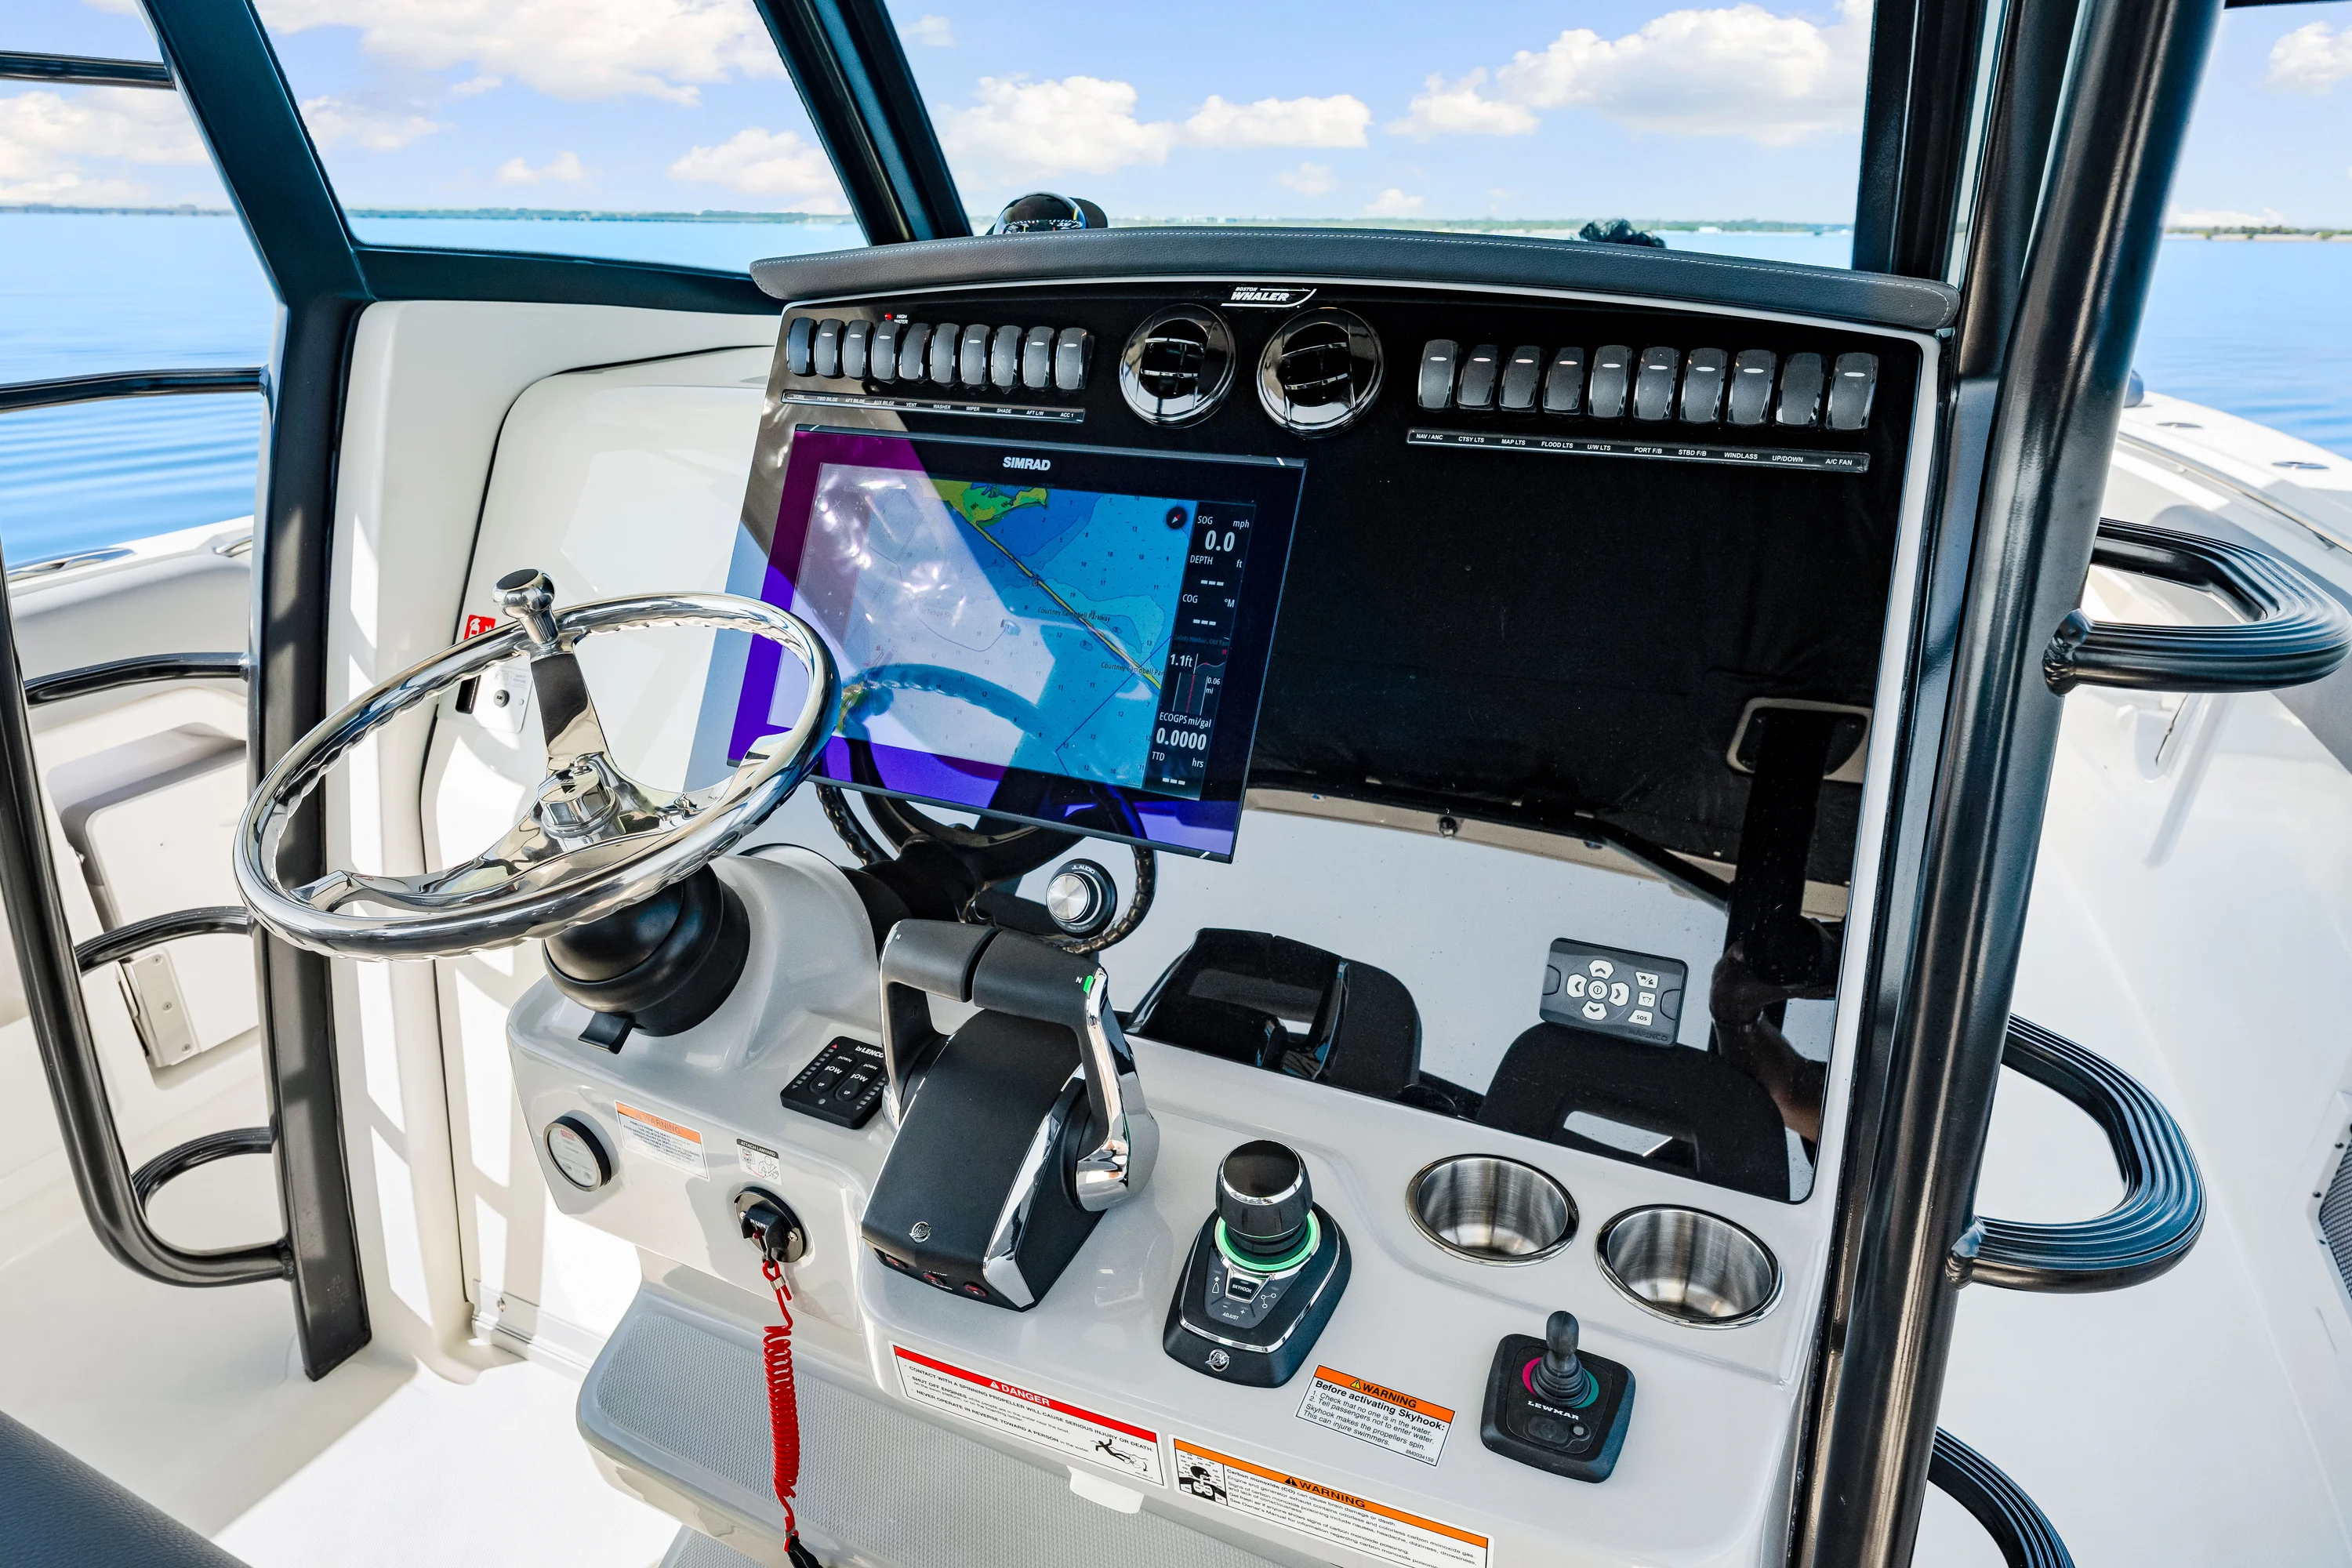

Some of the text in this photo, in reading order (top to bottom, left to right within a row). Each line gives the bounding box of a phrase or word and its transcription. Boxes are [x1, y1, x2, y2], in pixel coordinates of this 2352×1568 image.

[1230, 292, 1290, 301] WHALER
[1003, 456, 1051, 470] SIMRAD
[1197, 516, 1250, 530] SOG mph
[1205, 530, 1236, 552] 0.0
[1190, 555, 1243, 568] DEPTH ft
[1182, 594, 1235, 608] COG °M
[1038, 607, 1111, 622] Courtney Campbell Parkway
[1101, 661, 1125, 672] Courtney
[1127, 664, 1153, 675] Campbell
[1171, 654, 1192, 667] 1.1ft
[1160, 712, 1212, 729] ECOGPS mi/gal
[1156, 728, 1207, 750] 0.0000
[1152, 751, 1203, 768] TTD hrs
[1079, 865, 1095, 874] AUDIO
[1628, 1029, 1668, 1042] MARINCO
[861, 1047, 884, 1058] LENCO
[644, 1113, 681, 1134] WARNING
[740, 1140, 776, 1157] ATTACH LANYARD
[750, 1218, 766, 1229] RUN
[1232, 1283, 1252, 1294] SKYHOOK
[1222, 1312, 1239, 1320] ADJUST
[911, 1375, 927, 1385] SHUT
[940, 1386, 967, 1399] ENGINES
[1000, 1383, 1050, 1406] DANGER
[1363, 1382, 1417, 1408] WARNING
[909, 1366, 935, 1378] CONTACT
[936, 1375, 953, 1385] WITH
[958, 1383, 988, 1396] SPINNING
[988, 1393, 1025, 1409] PROPELLER
[1025, 1406, 1041, 1414] WILL
[1041, 1411, 1063, 1422] CAUSE
[1065, 1419, 1093, 1432] SERIOUS
[1094, 1428, 1117, 1439] INJURY
[1130, 1441, 1152, 1451] DEATH.
[1315, 1379, 1445, 1431] Before activating Skyhook:
[1319, 1392, 1341, 1404] Check
[1342, 1400, 1356, 1410] that
[1367, 1410, 1381, 1418] one
[1397, 1419, 1410, 1428] the
[1410, 1425, 1432, 1436] water.
[1528, 1400, 1579, 1421] LEWMAR
[916, 1389, 935, 1399] NEVER
[936, 1396, 963, 1409] OPERATE
[971, 1409, 999, 1421] REVERSE
[999, 1418, 1026, 1431] TOWARD
[1033, 1430, 1058, 1442] PERSON
[1318, 1397, 1330, 1406] Tell
[1330, 1403, 1370, 1421] passengers
[1371, 1417, 1384, 1426] not
[1392, 1425, 1412, 1436] enter
[1413, 1432, 1433, 1444] water.
[1303, 1409, 1389, 1446] This can injure swimmers.
[1305, 1403, 1425, 1450] Skyhook makes the propellers spin.
[1226, 1468, 1248, 1479] Carbon
[1250, 1476, 1279, 1489] monoxide
[1280, 1486, 1295, 1494] (CO)
[1344, 1507, 1369, 1518] damage
[1298, 1480, 1365, 1508] WARNING
[1226, 1475, 1247, 1484] Engine
[1260, 1486, 1287, 1497] generator
[1288, 1496, 1312, 1505] exhaust
[1312, 1503, 1338, 1514] contains
[1338, 1512, 1364, 1523] odorless
[1378, 1524, 1406, 1536] colorless
[1406, 1534, 1428, 1543] carbon
[1429, 1541, 1461, 1553] monoxide
